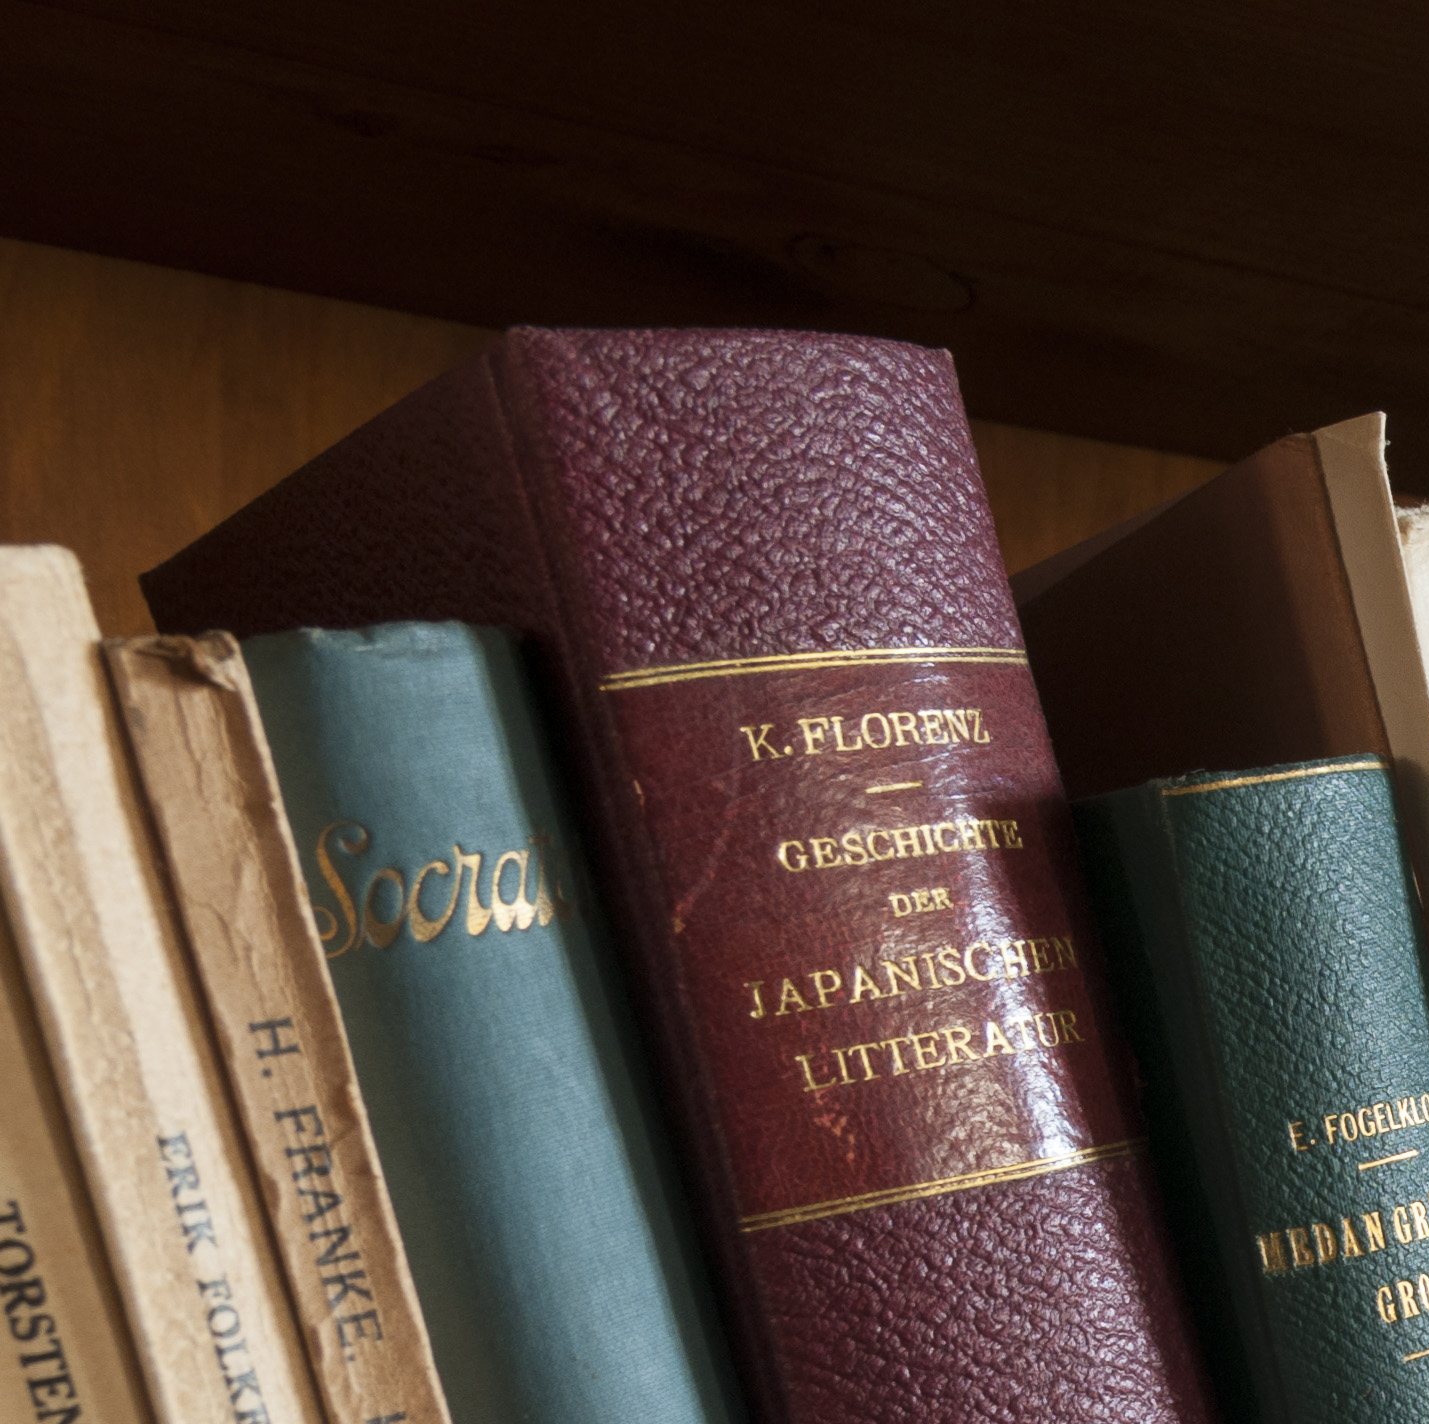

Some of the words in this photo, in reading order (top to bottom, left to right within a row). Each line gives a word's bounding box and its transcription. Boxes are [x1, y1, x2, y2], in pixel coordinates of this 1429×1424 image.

[740, 722, 794, 762] K.
[797, 707, 991, 756] FLORENZ
[777, 818, 1024, 874] GESCHICHTE
[887, 886, 954, 919] DER
[743, 936, 1081, 1020] JAPANISCHEN
[795, 1009, 1086, 1093] LITTERATUR
[1288, 1120, 1317, 1152] E.
[156, 1130, 219, 1255] ERIK
[248, 1016, 300, 1079] H.
[274, 1103, 384, 1365] FRANKE.
[1255, 1209, 1387, 1276] MEDAN
